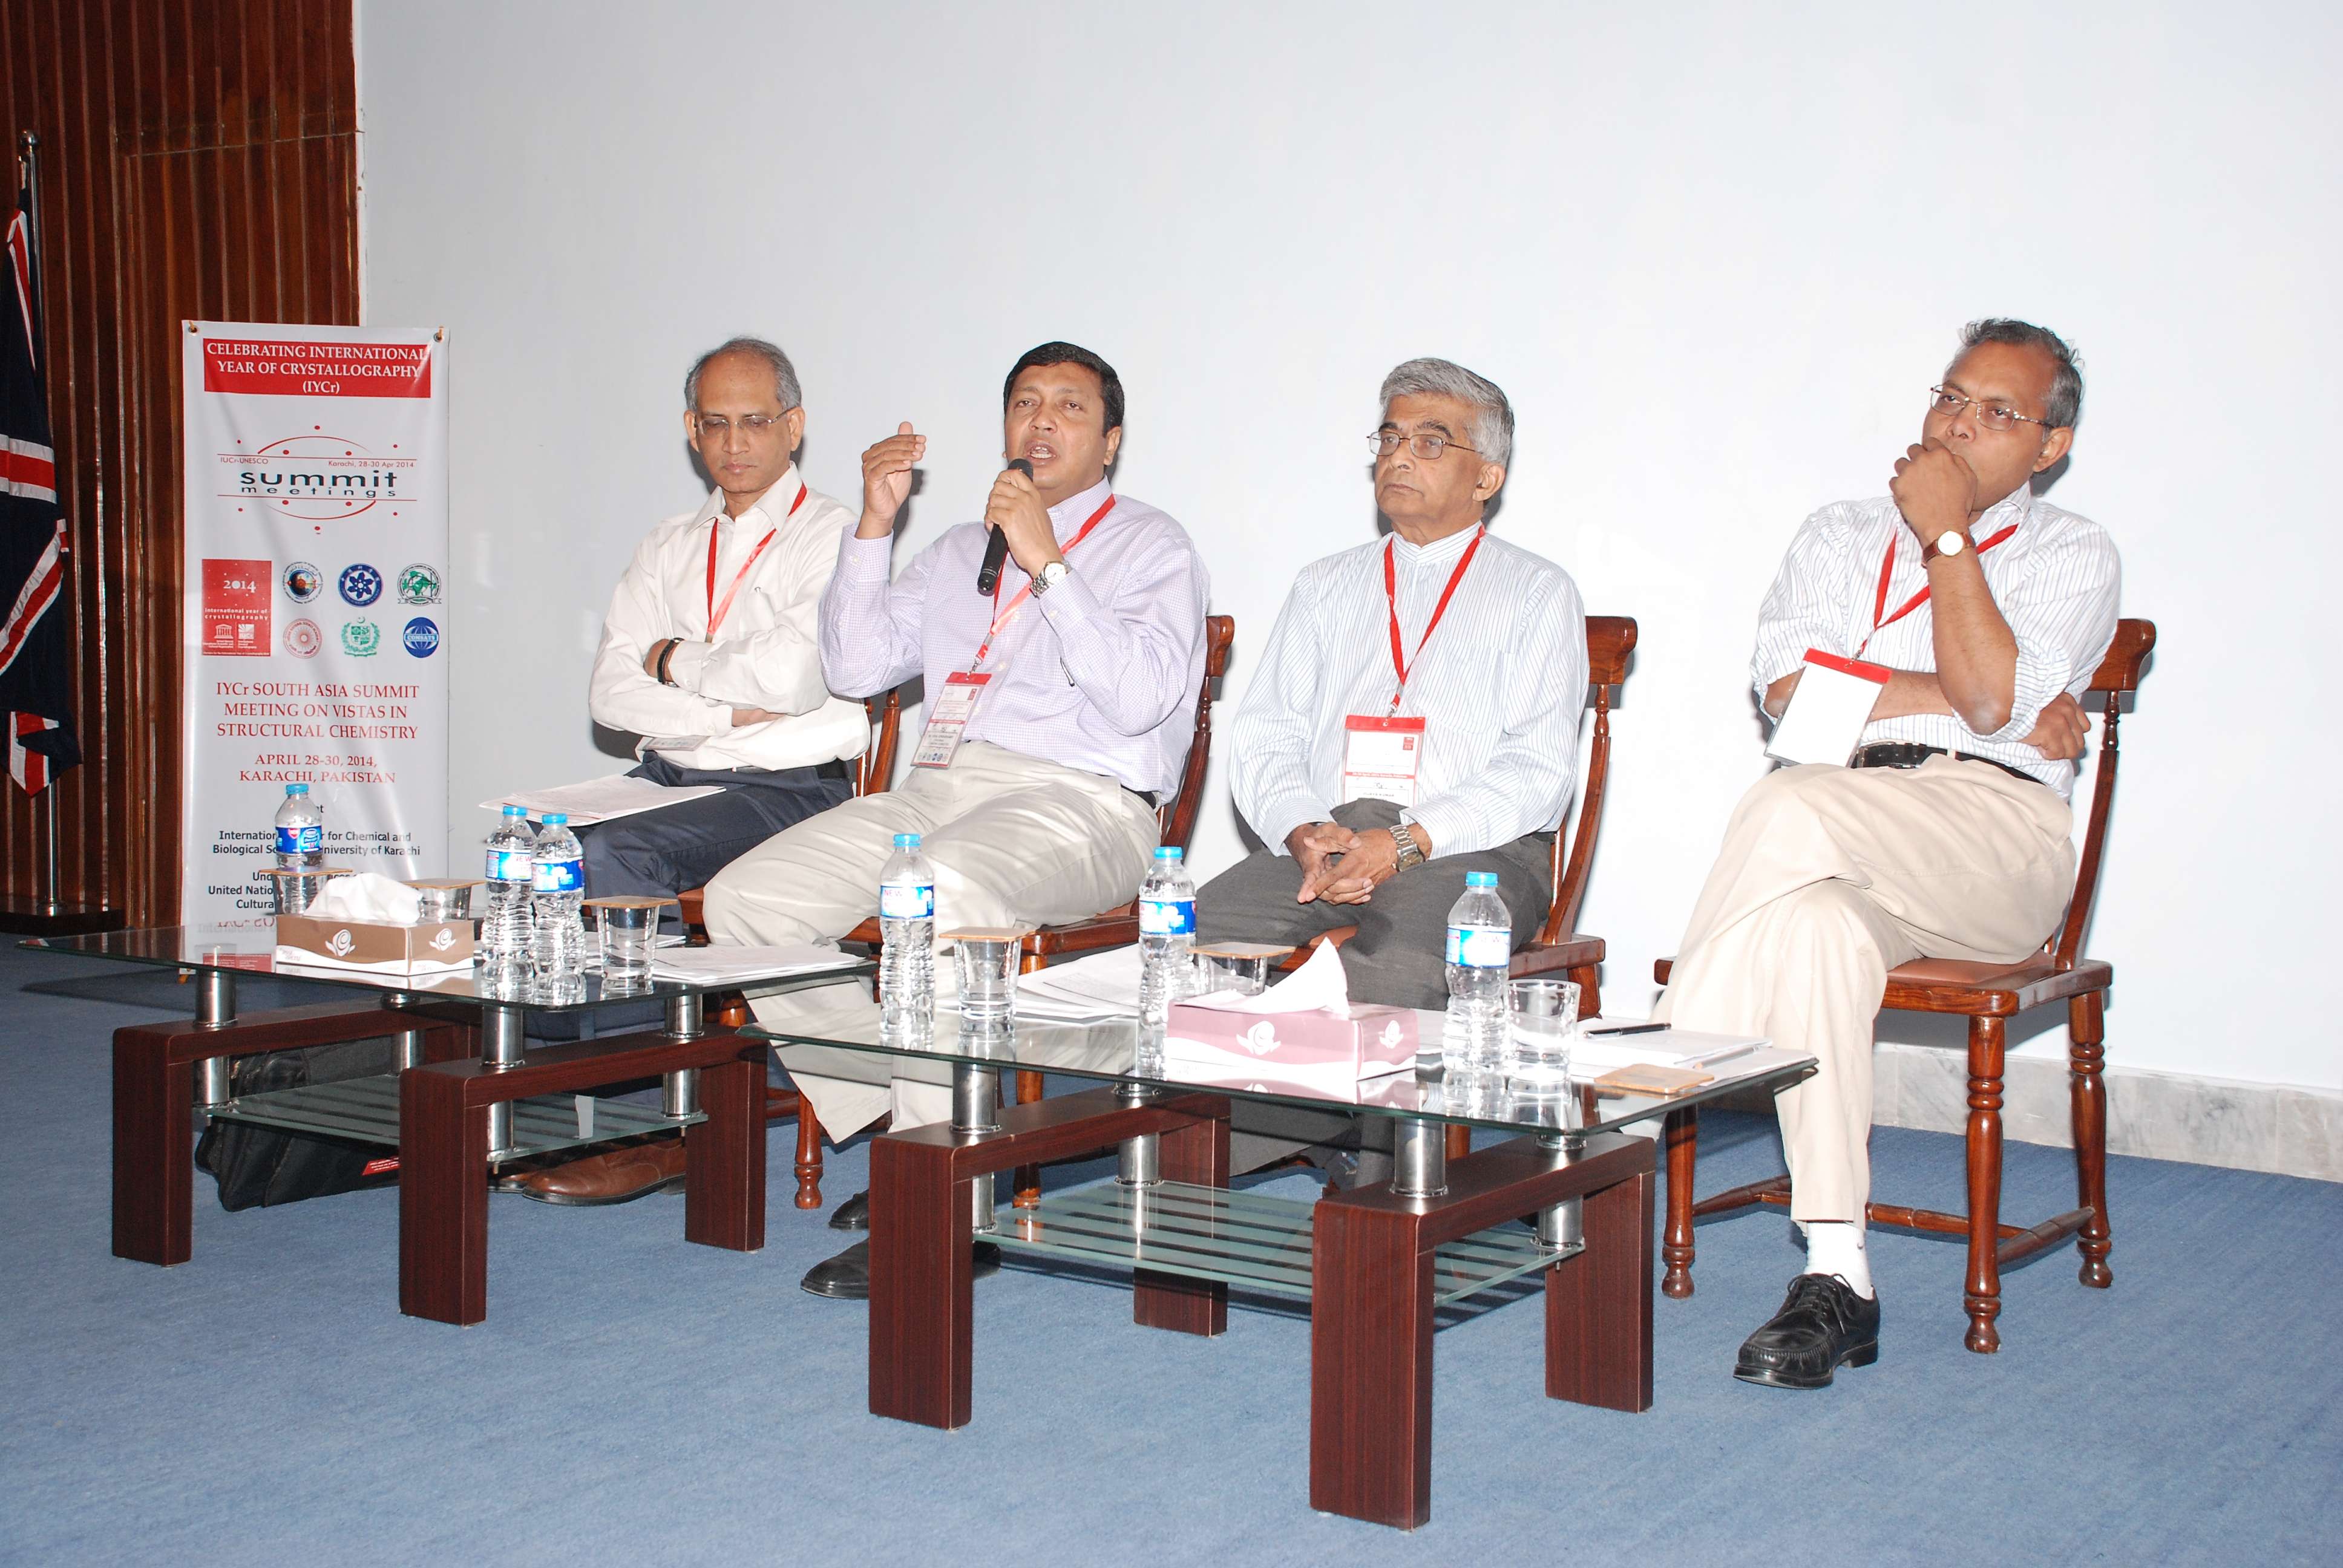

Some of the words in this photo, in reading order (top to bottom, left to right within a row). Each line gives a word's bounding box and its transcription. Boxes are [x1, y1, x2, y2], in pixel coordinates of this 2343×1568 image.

[207, 342, 306, 358] CELEBRATING
[309, 346, 428, 361] INTERNATIONAL
[217, 360, 255, 373] YEAR
[258, 362, 277, 374] OF
[280, 362, 420, 377] CRYSTALLOGRAPHY
[303, 381, 340, 394] (IYCr)
[240, 470, 397, 488] summit
[241, 486, 396, 498] meetings
[223, 580, 256, 593] 2014
[216, 682, 250, 696] IYCr
[253, 683, 309, 697] SOUTH
[314, 684, 349, 697] ASIA
[353, 684, 419, 698] SUMMIT
[224, 703, 299, 717] MEETING
[304, 705, 328, 717] ON
[333, 705, 385, 719] VISTAS
[390, 705, 407, 719] IN
[217, 723, 324, 737] STRUCTURAL
[329, 725, 418, 739] CHEMISTRY
[255, 754, 300, 765] APRIL
[305, 755, 343, 768] 28-30,
[347, 756, 378, 768] 2014,
[240, 770, 316, 783] KARACHI,
[321, 770, 396, 783] PAKISTAN
[219, 831, 276, 840] Internation
[328, 831, 343, 840] for
[346, 831, 390, 841] Chemical
[393, 832, 411, 842] and
[213, 844, 263, 855] Biological
[324, 844, 369, 856] niversity
[371, 846, 381, 854] of
[208, 886, 242, 895] United
[246, 886, 273, 895] Natio
[237, 899, 274, 909] Cultura
